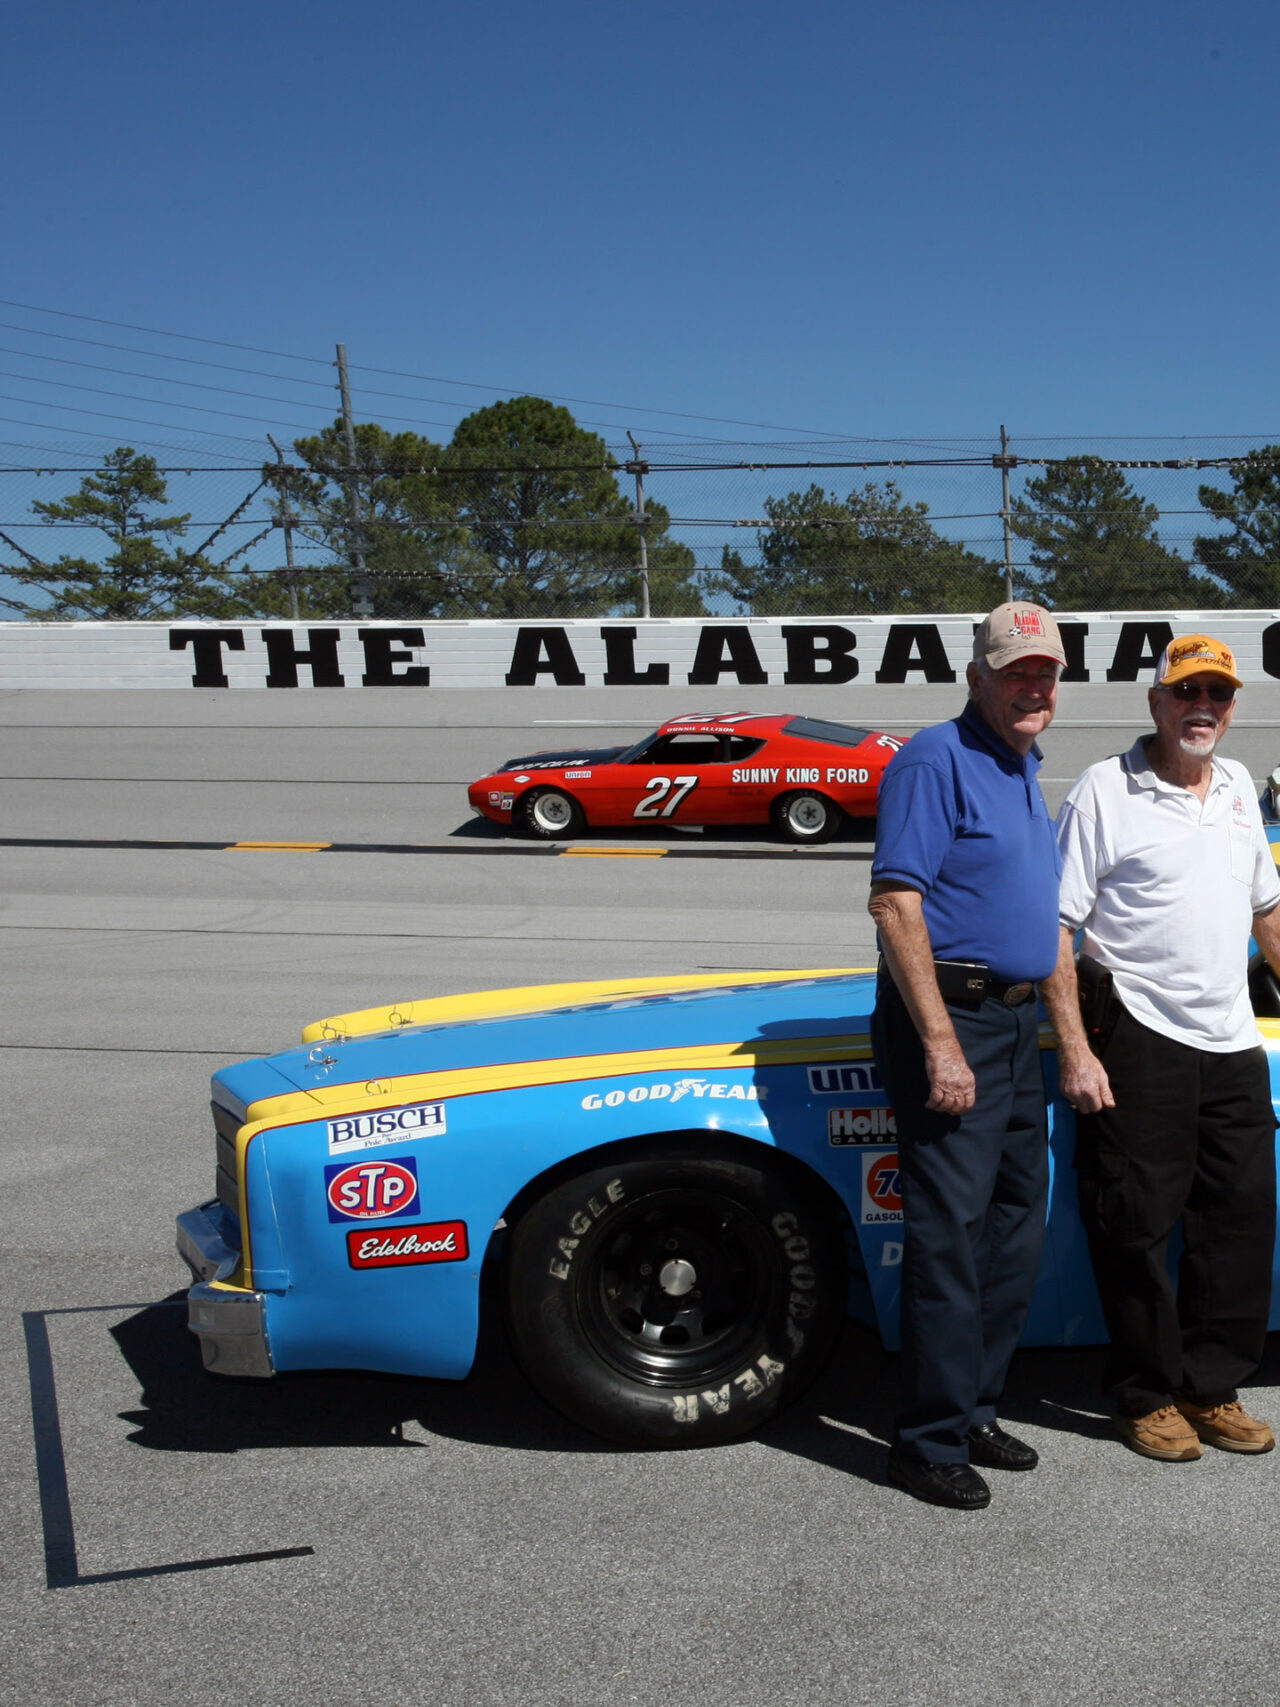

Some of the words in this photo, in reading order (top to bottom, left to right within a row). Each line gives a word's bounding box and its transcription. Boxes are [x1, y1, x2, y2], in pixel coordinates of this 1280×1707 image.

[168, 627, 431, 688] THE
[732, 768, 780, 784] SUNNY
[786, 768, 820, 784] KING
[827, 768, 869, 784] FORD
[633, 776, 699, 819] 27
[581, 1078, 768, 1110] GOODYEAR
[810, 1066, 885, 1092] uni
[330, 1104, 444, 1144] BUSCH
[831, 1110, 897, 1136] Holle
[364, 1138, 382, 1148] Pole
[384, 1132, 412, 1143] Award
[339, 1167, 405, 1208] STP
[550, 1178, 626, 1281] EAGLE
[865, 1212, 903, 1222] GASOL
[358, 1232, 456, 1260] Edelbrock
